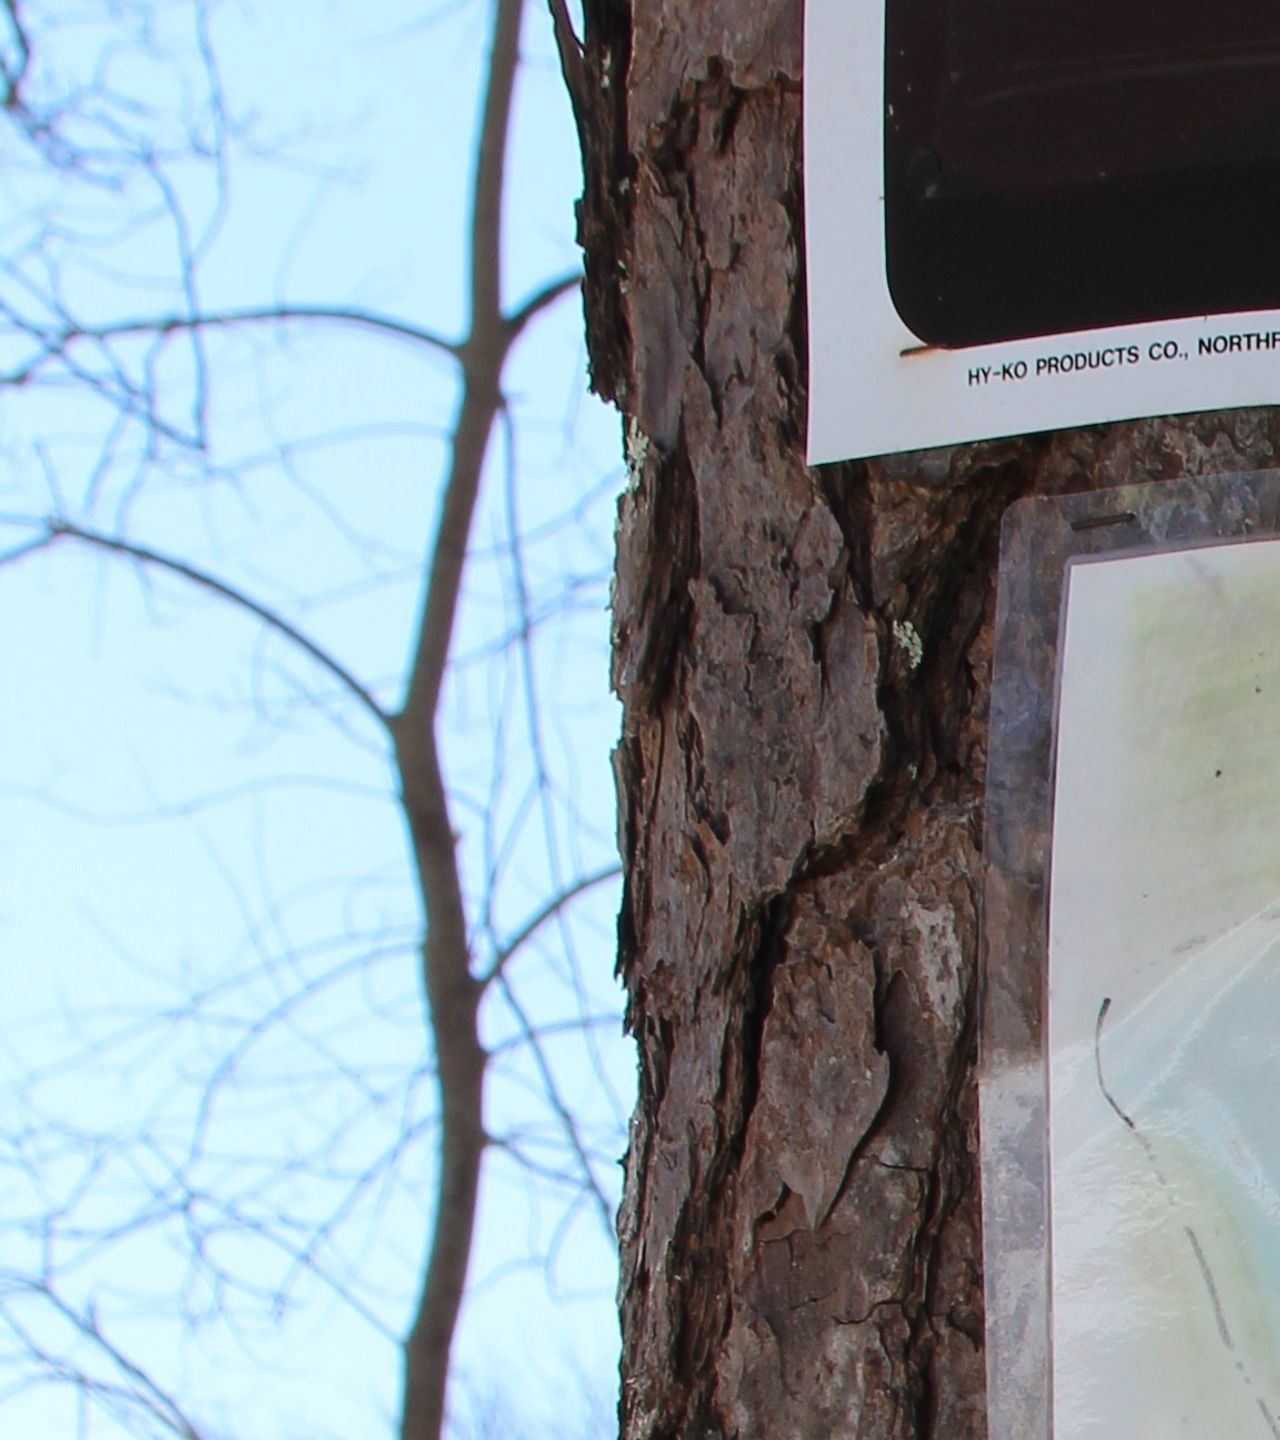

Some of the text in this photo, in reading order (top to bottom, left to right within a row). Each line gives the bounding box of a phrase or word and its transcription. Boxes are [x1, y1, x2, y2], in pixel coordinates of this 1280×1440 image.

[967, 361, 1027, 388] HY-KO
[1036, 347, 1139, 378] PRODUCTS
[1148, 340, 1190, 363] CO.,
